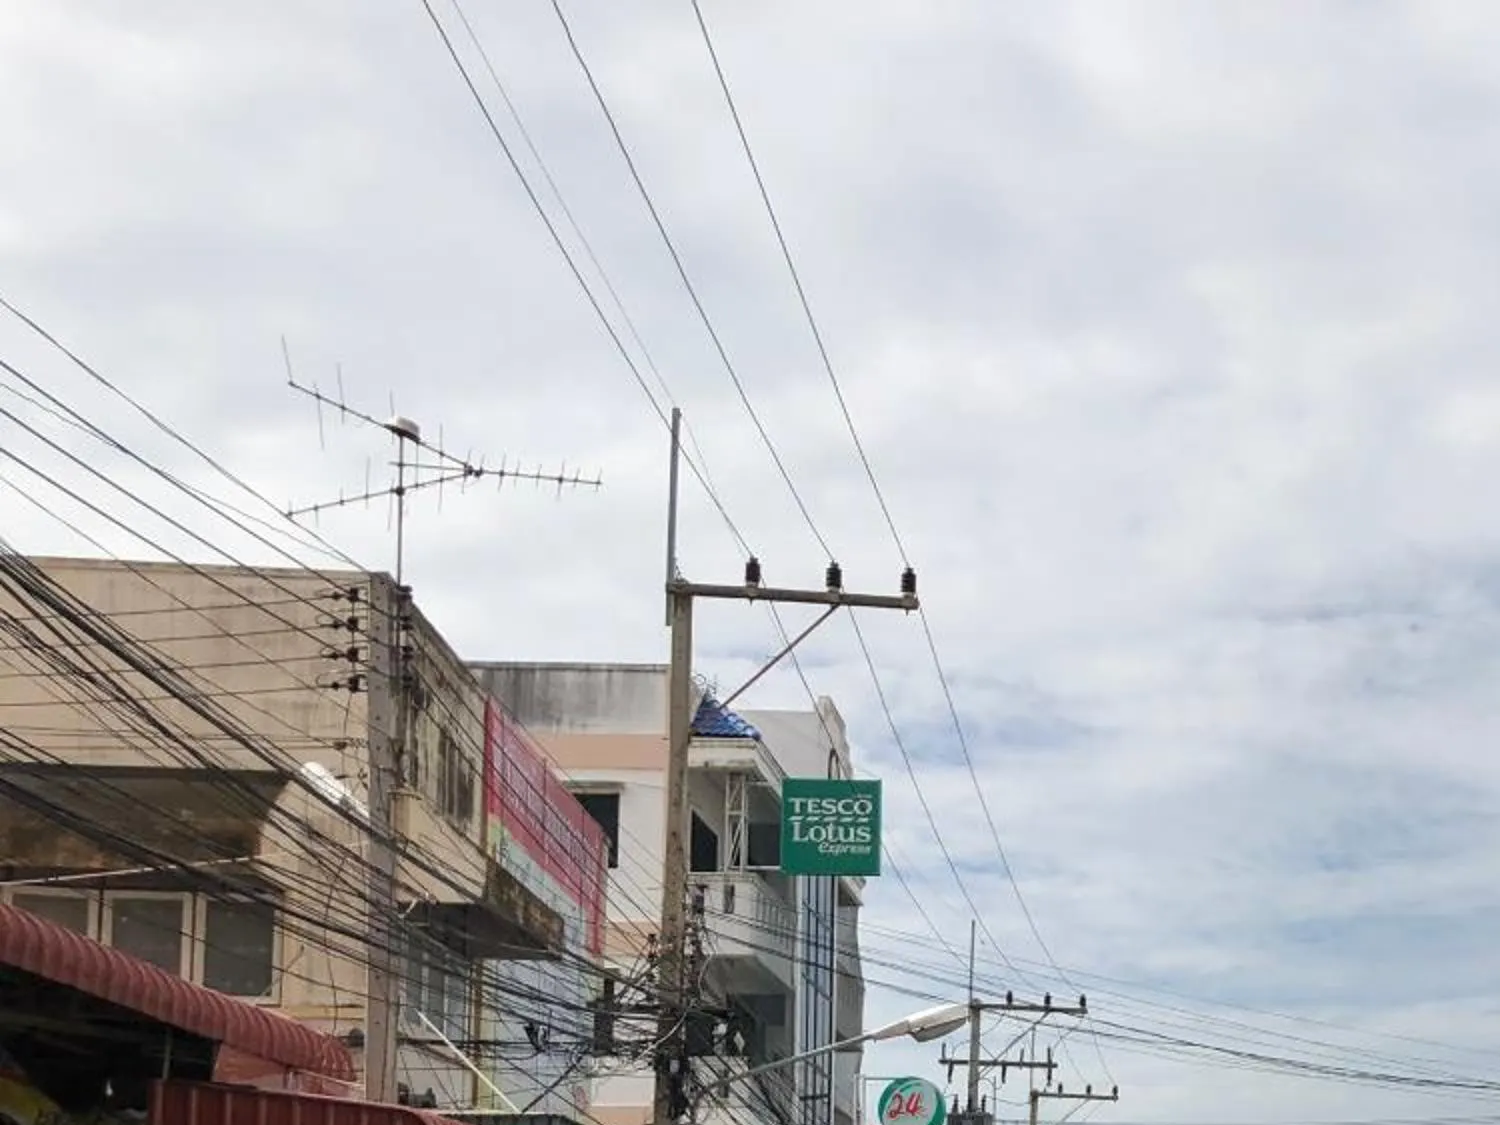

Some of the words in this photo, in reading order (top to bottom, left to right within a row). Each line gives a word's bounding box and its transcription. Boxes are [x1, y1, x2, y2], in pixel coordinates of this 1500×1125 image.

[788, 797, 873, 815] TESCO
[791, 821, 872, 842] Lotus
[888, 1092, 922, 1119] 24
